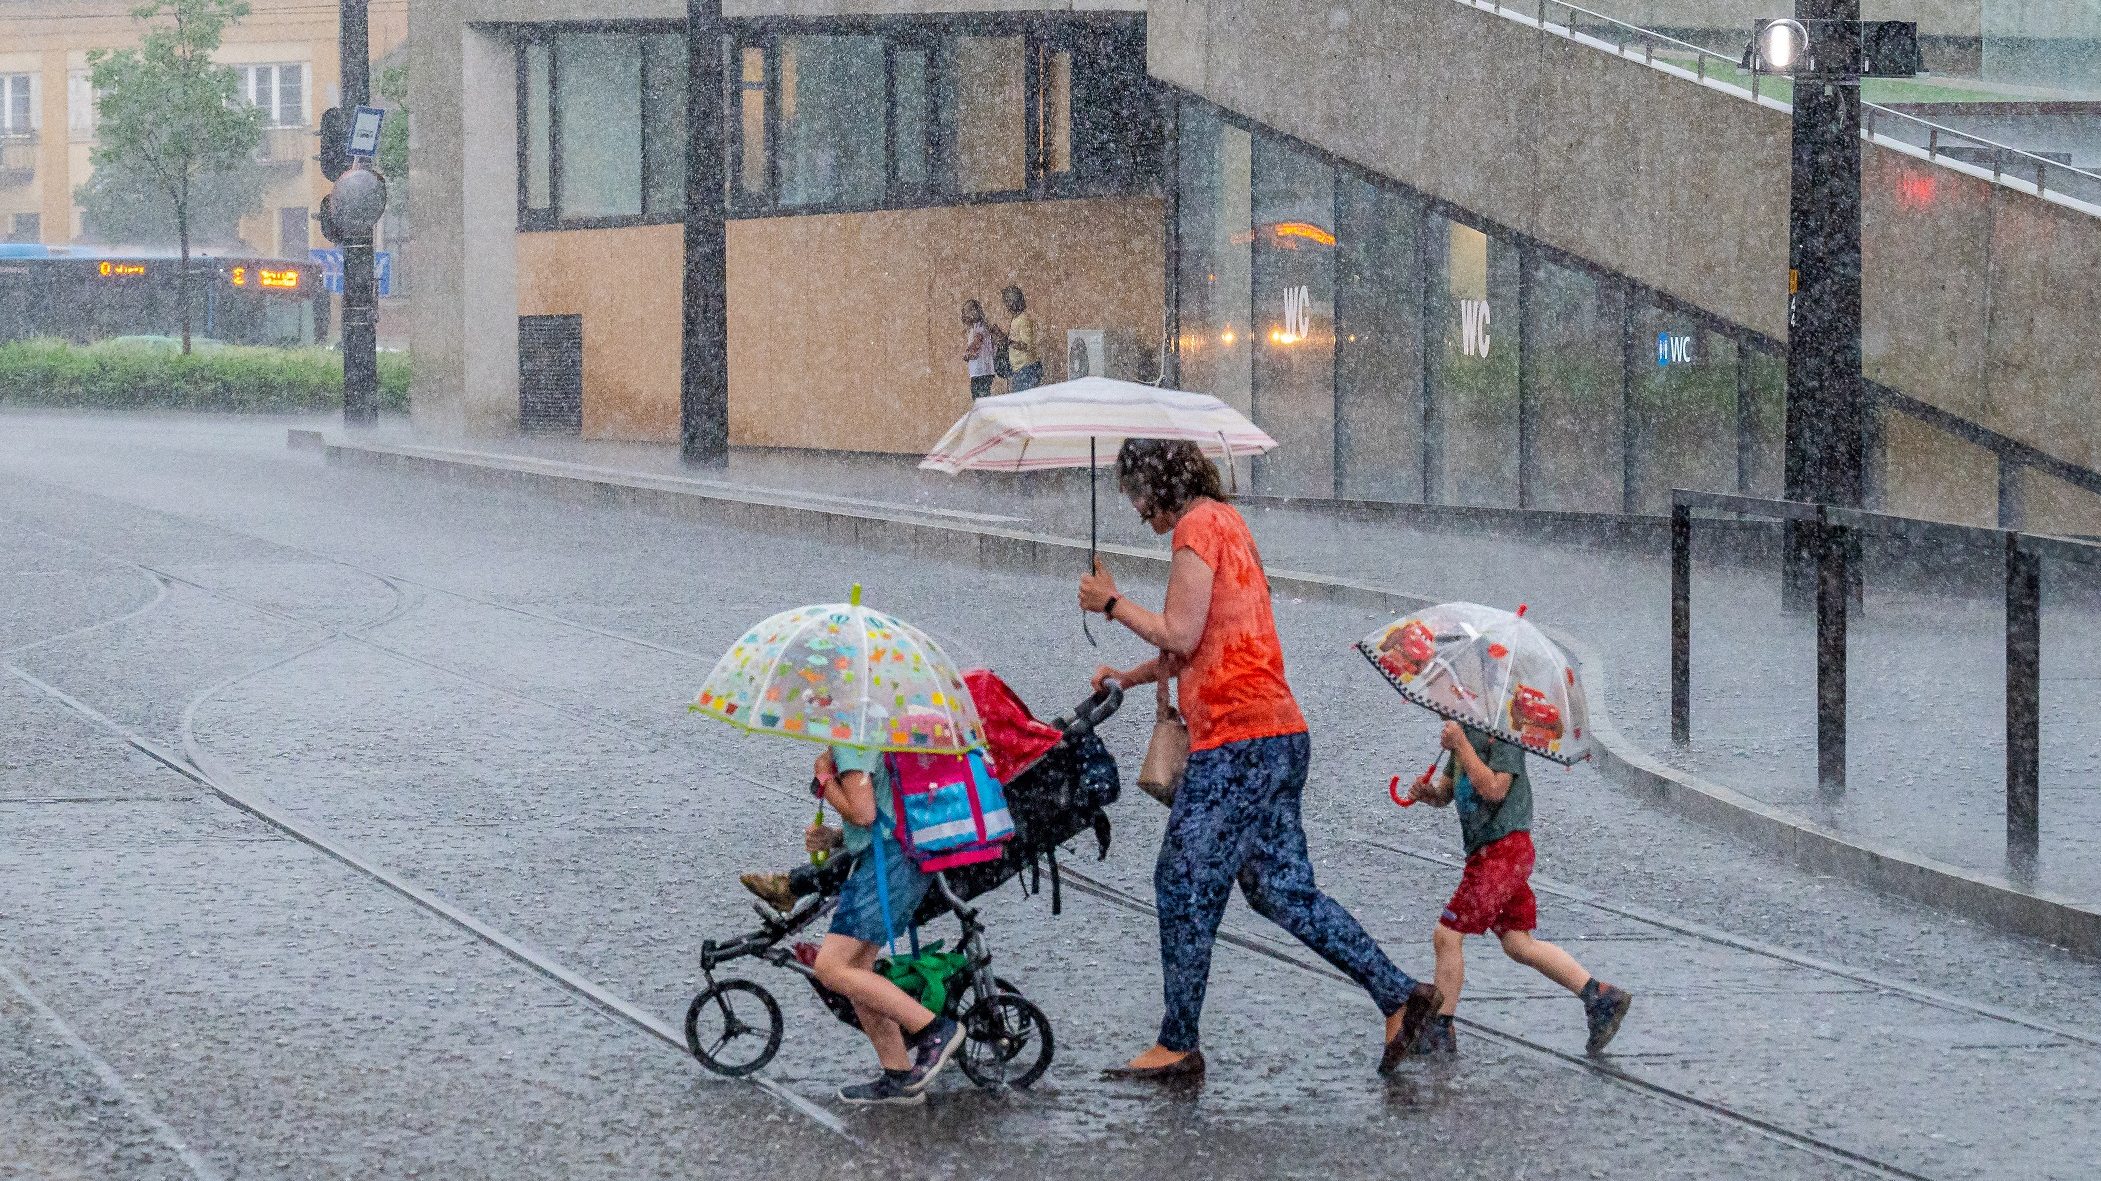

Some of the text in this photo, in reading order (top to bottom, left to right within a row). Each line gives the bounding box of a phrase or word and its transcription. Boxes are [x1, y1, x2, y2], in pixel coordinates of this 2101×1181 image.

[1284, 285, 1309, 338] WC
[1461, 299, 1490, 359] WC
[1670, 337, 1691, 363] WC
